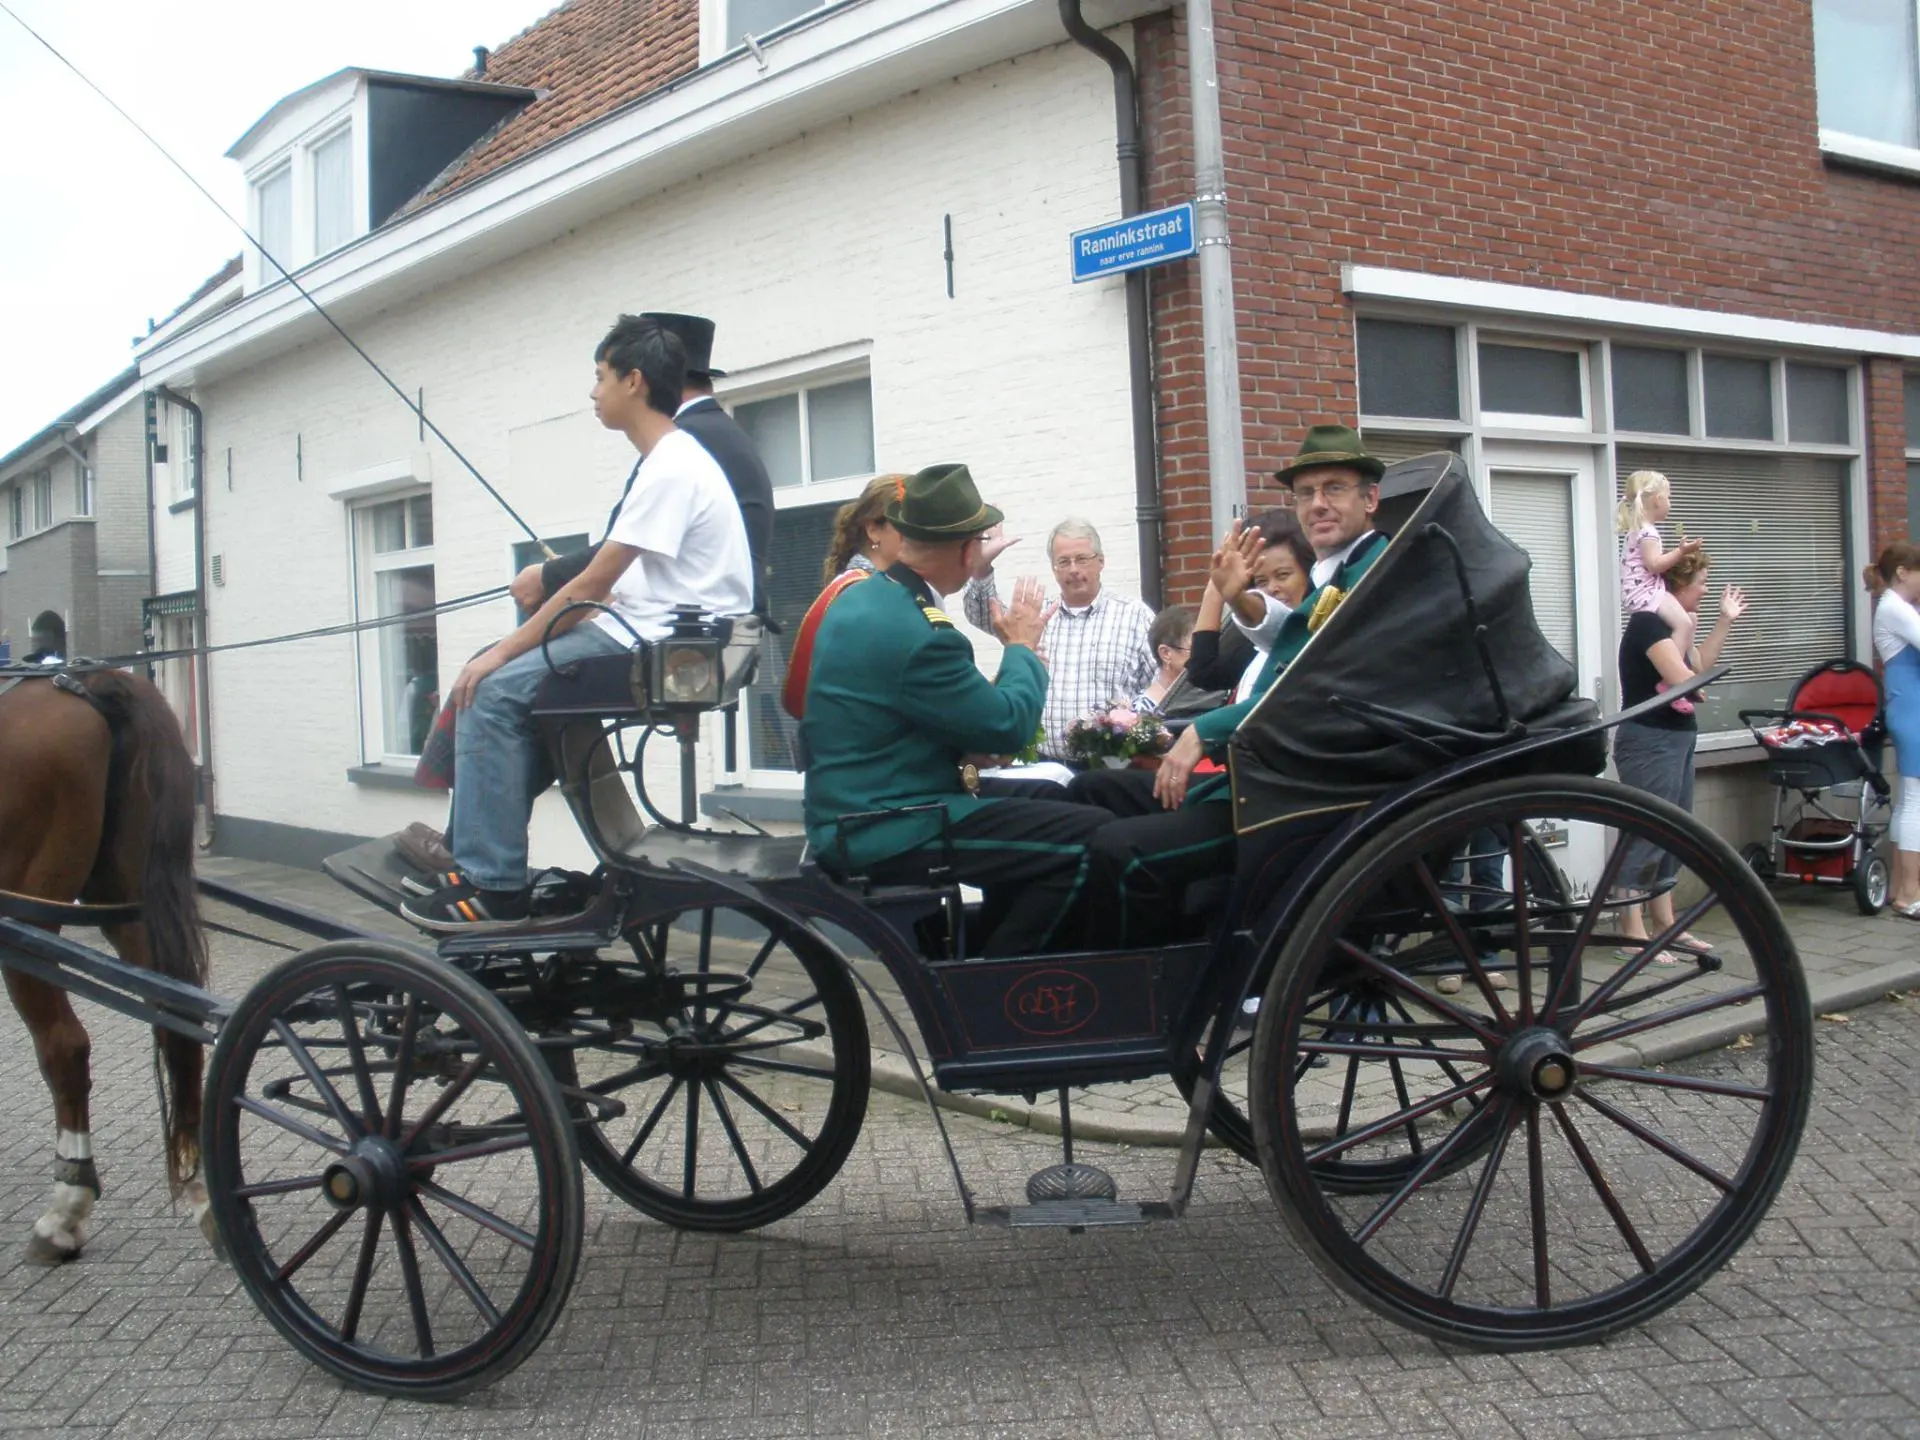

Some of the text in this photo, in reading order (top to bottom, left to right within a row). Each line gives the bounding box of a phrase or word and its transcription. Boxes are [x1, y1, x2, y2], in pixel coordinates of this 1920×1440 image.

[1081, 215, 1183, 257] Ranninkstraat
[1100, 242, 1165, 266] naar erve rannink
